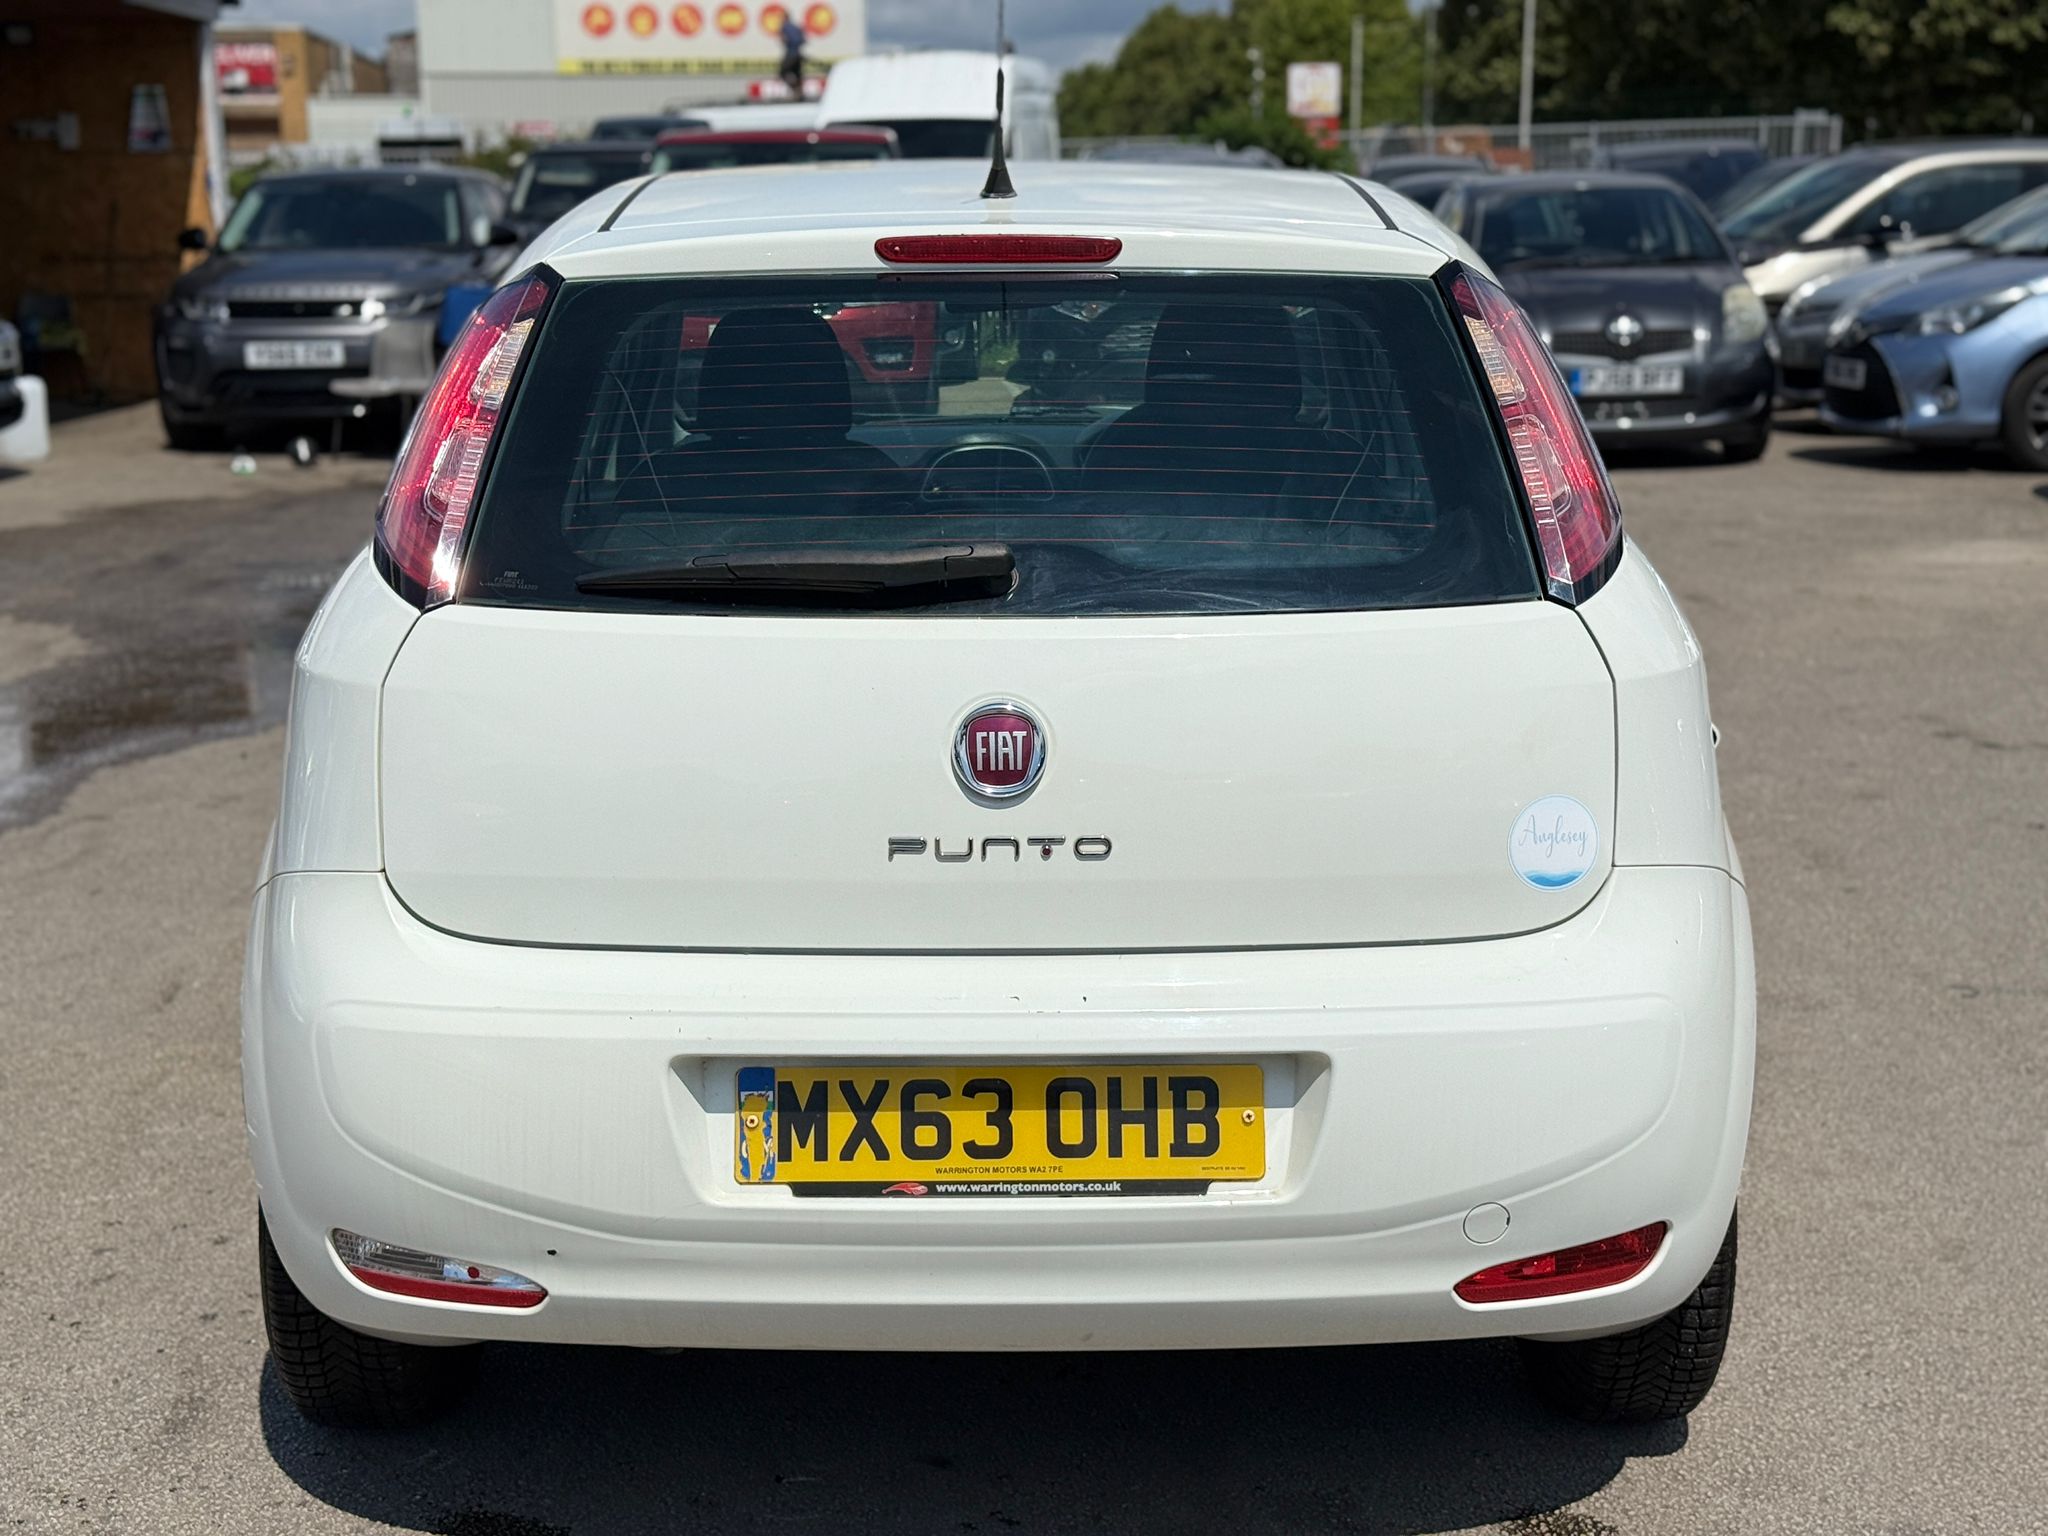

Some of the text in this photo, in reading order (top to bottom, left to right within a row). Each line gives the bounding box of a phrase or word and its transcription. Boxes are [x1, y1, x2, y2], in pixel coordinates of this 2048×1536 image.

[976, 731, 1027, 771] FIAT
[888, 835, 1112, 863] PUNTO
[1518, 814, 1588, 858] Anglesey
[776, 1075, 1220, 1163] MX63 OHB
[935, 1166, 990, 1175] WARRINGTON
[991, 1166, 1028, 1174] MOTORS
[1048, 1165, 1063, 1173] 7PE
[936, 1181, 1122, 1195] www.warringtonmotors.co.uk
